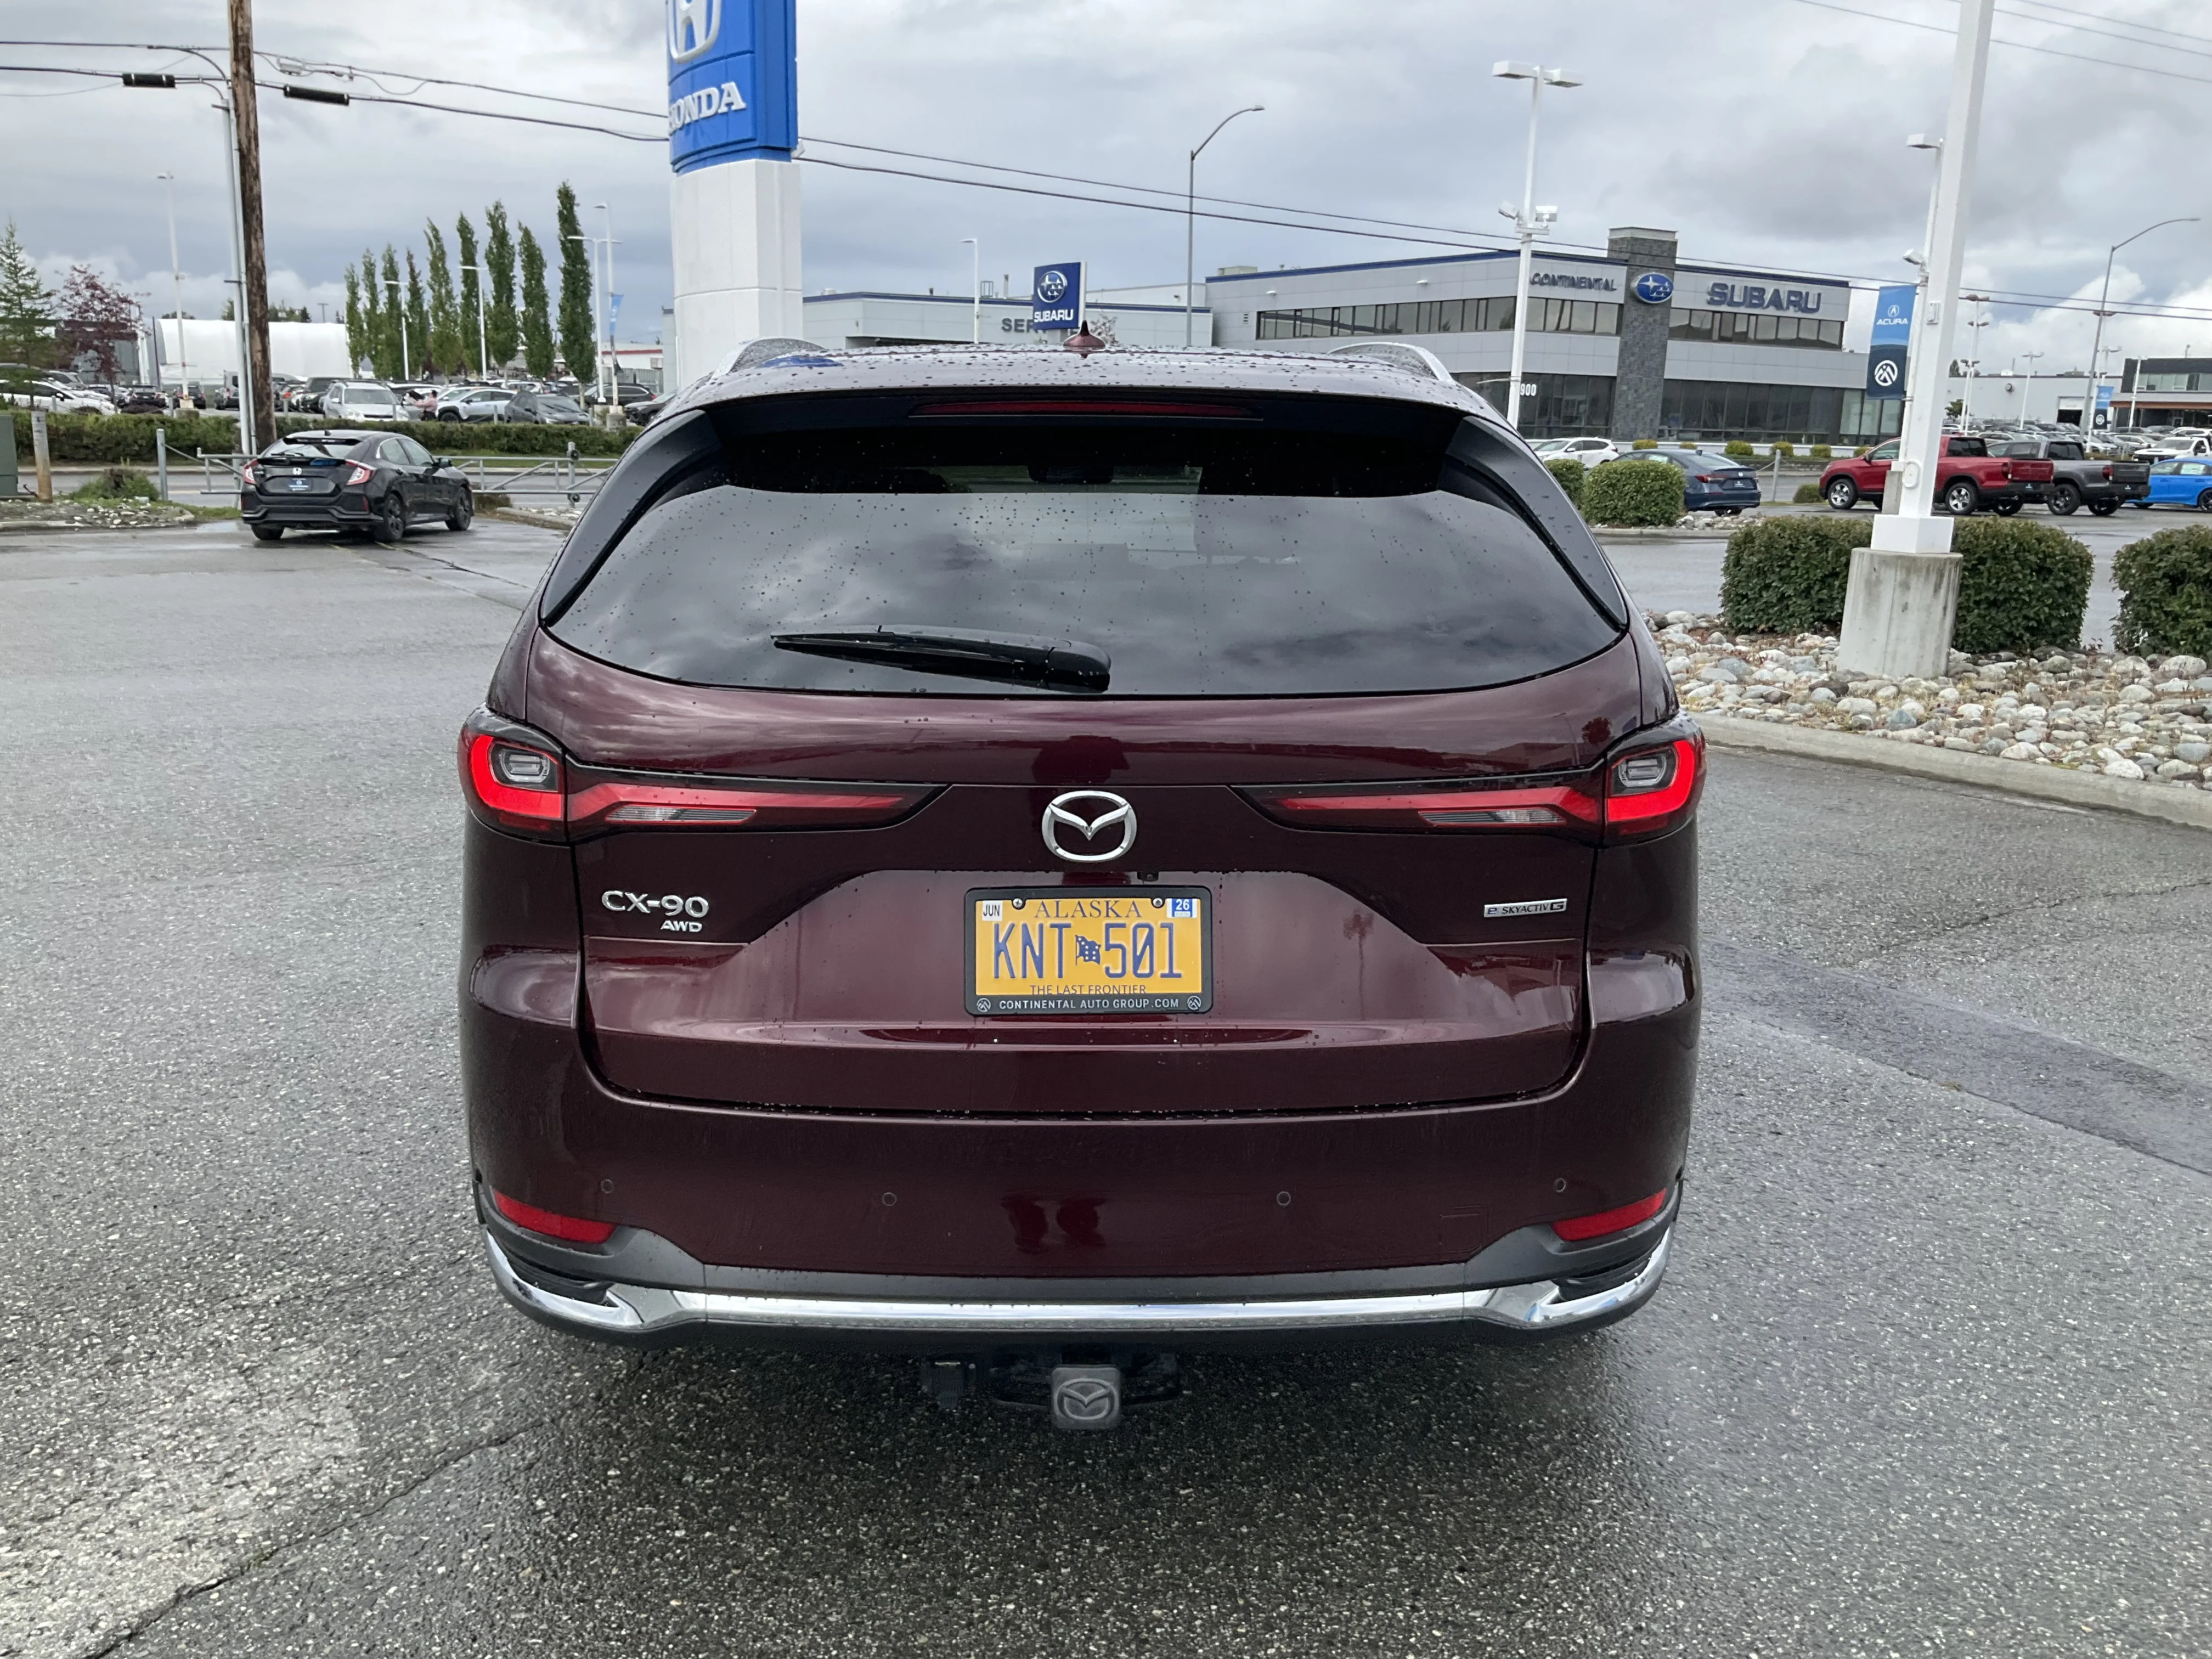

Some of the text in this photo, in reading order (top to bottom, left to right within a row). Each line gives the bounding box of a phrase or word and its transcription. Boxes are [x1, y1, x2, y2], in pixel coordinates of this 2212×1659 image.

[1531, 272, 1617, 291] CONTINENTAL
[1707, 282, 1821, 313] SUBARU
[1034, 309, 1074, 323] SUBARU
[1520, 383, 1537, 396] 900
[601, 890, 709, 918] CX-90
[983, 904, 1000, 916] JUN
[1034, 900, 1142, 918] ALASKA
[1176, 899, 1190, 911] 26
[660, 919, 702, 933] AWD
[994, 922, 1182, 979] KNT 501
[1030, 985, 1146, 995] THE LAST FRONTIER
[999, 1000, 1076, 1010] CONTINENTAL
[1080, 999, 1109, 1009] AUTO
